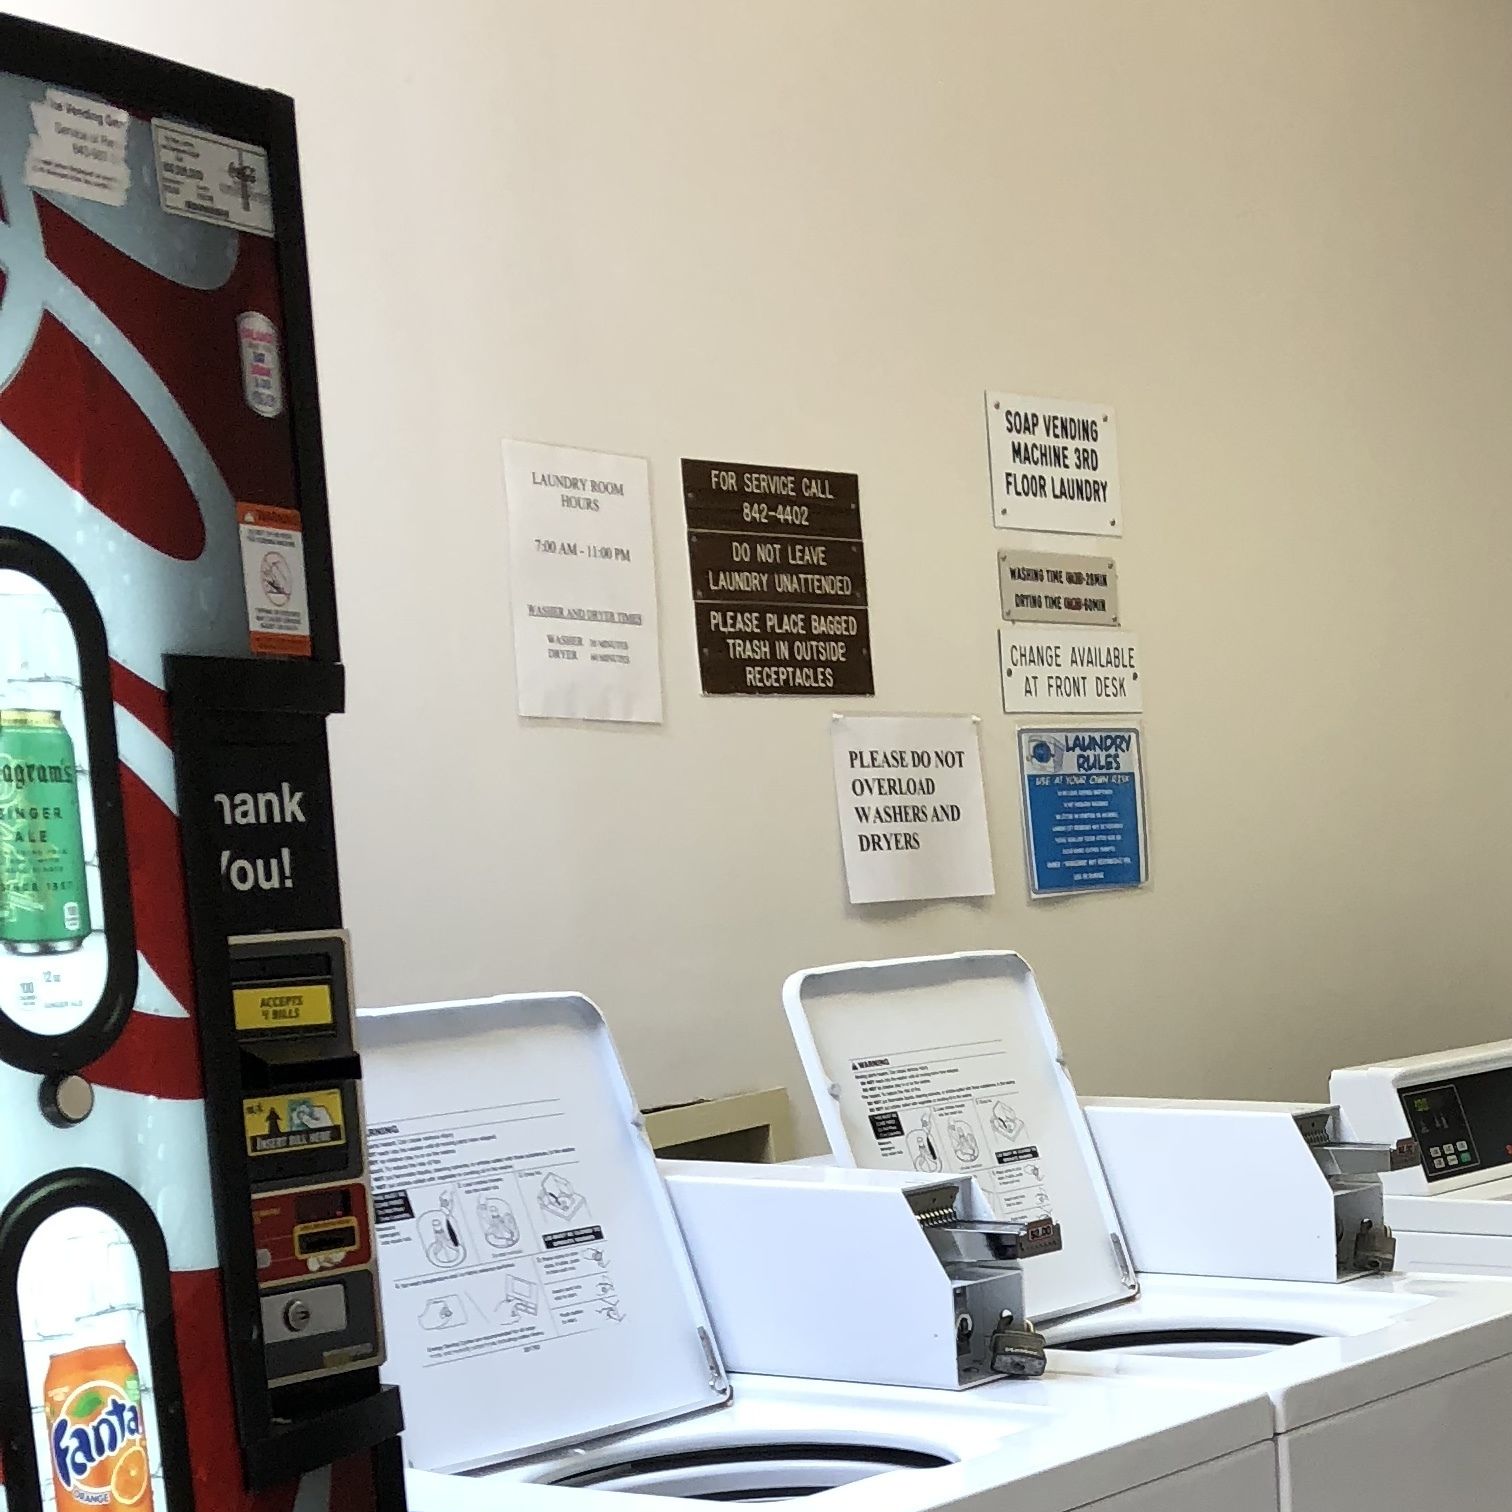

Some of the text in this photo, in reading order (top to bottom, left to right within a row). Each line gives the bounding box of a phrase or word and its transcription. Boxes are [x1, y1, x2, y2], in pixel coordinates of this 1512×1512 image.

[1005, 409, 1098, 443] SOAP VENDING
[1011, 441, 1098, 471] MACHINE 3RD
[531, 472, 625, 496] LAUNDRY ROOM
[711, 470, 835, 499] FOR SERVICE CALL
[1005, 472, 1108, 503] FLOOR LAUNDRY
[561, 494, 600, 512] HOURS
[742, 502, 809, 525] 842-4402
[534, 539, 556, 554] 7:00
[559, 543, 578, 556] AM
[588, 545, 612, 560] 11:00
[615, 548, 631, 562] PM
[732, 542, 827, 566] DO NOT LEAVE
[708, 571, 852, 596] LAUNDRY UNATTENDED
[1009, 566, 1044, 582] WASHING
[1046, 569, 1064, 584] TIME
[710, 612, 858, 637] PLEASE PLACE BAGGED
[726, 639, 847, 662] TRASH IN OUTSIDE
[1010, 644, 1136, 669] CHANGE AVAILABLE
[745, 666, 834, 687] RECEPTACLES
[1024, 675, 1127, 698] AT FRONT DESK
[1065, 734, 1132, 753] LAUNDRY
[848, 750, 965, 768] PLEASE DO NOT
[1076, 753, 1121, 772] RULES
[851, 777, 936, 796] OVERLOAD
[854, 804, 961, 824] WASHERS AND
[15, 830, 48, 843] ALE
[858, 832, 921, 852] DRYERS
[260, 995, 304, 1008] ACCEPTS
[271, 1007, 300, 1020] BILLS
[858, 1058, 890, 1069] WARNING
[367, 1125, 400, 1137] RNING
[72, 1486, 109, 1503] ORANGE
